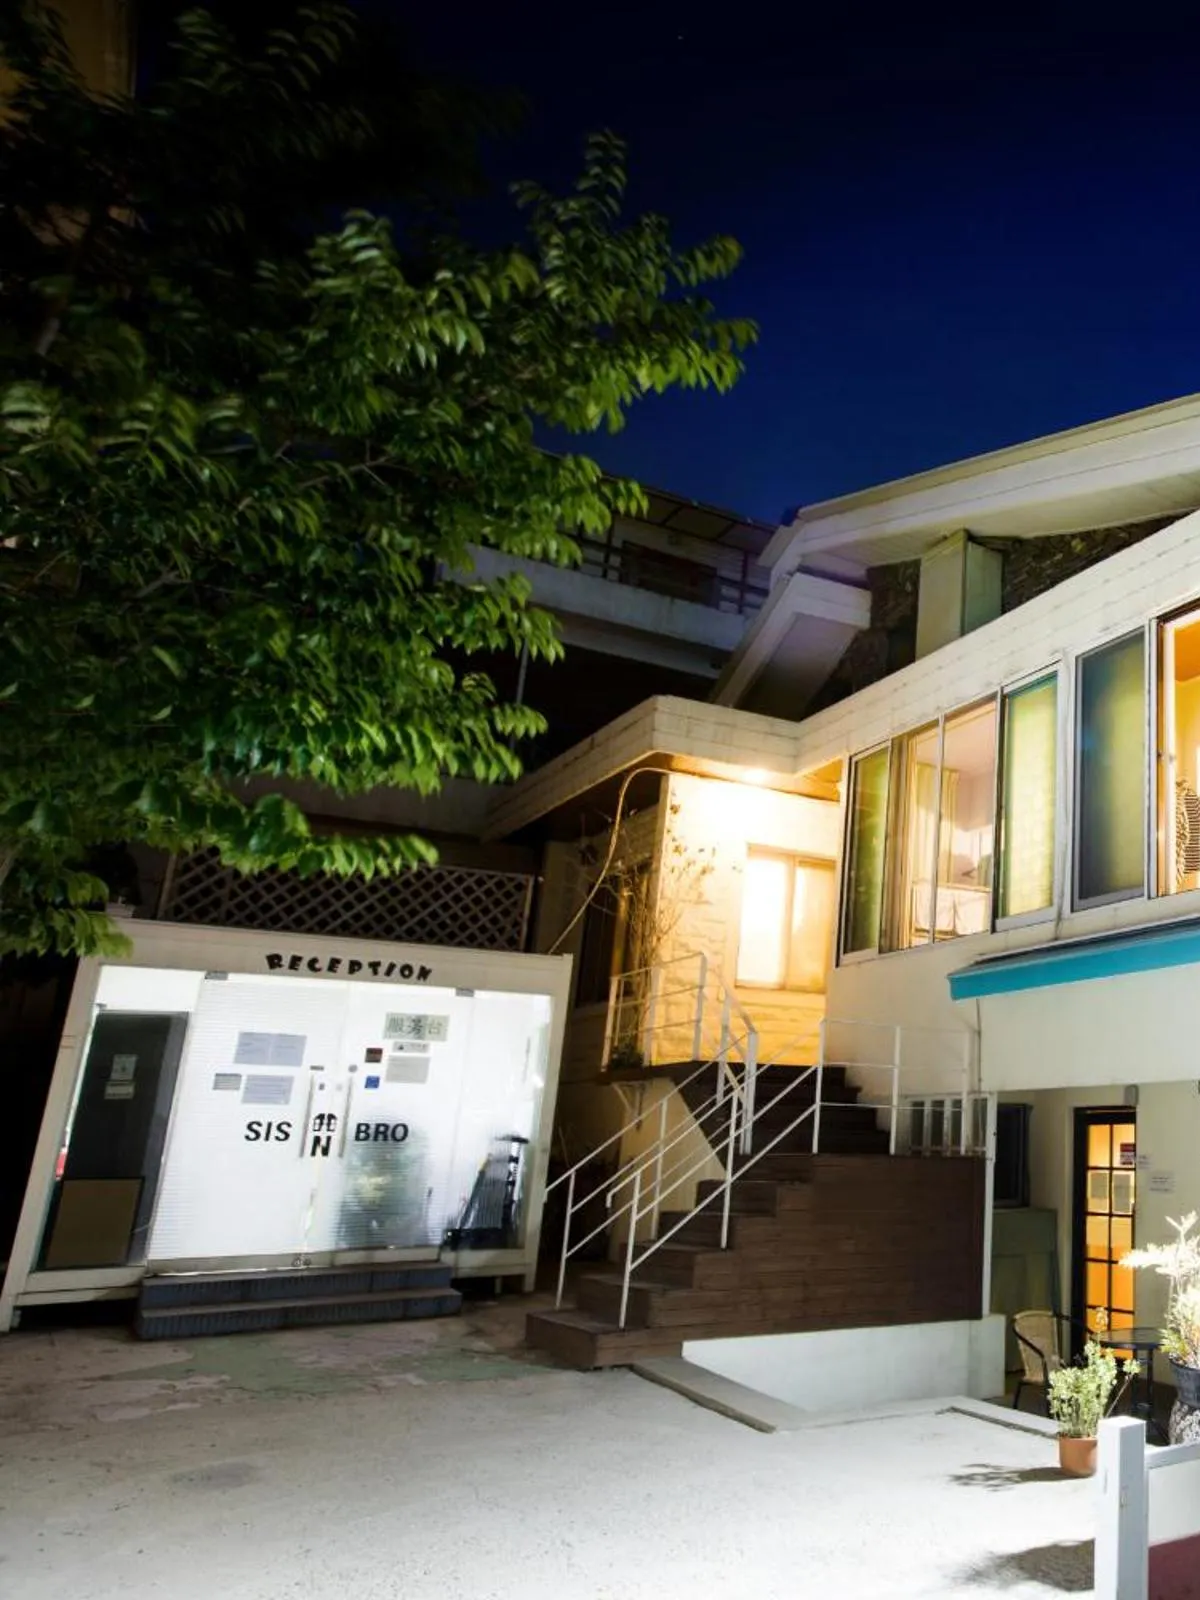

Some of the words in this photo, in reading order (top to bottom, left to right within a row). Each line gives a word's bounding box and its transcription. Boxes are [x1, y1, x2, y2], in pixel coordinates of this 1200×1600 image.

[266, 953, 433, 981] RECEPTION
[244, 1120, 293, 1142] SIS
[310, 1135, 331, 1157] N
[354, 1122, 409, 1142] BRO
